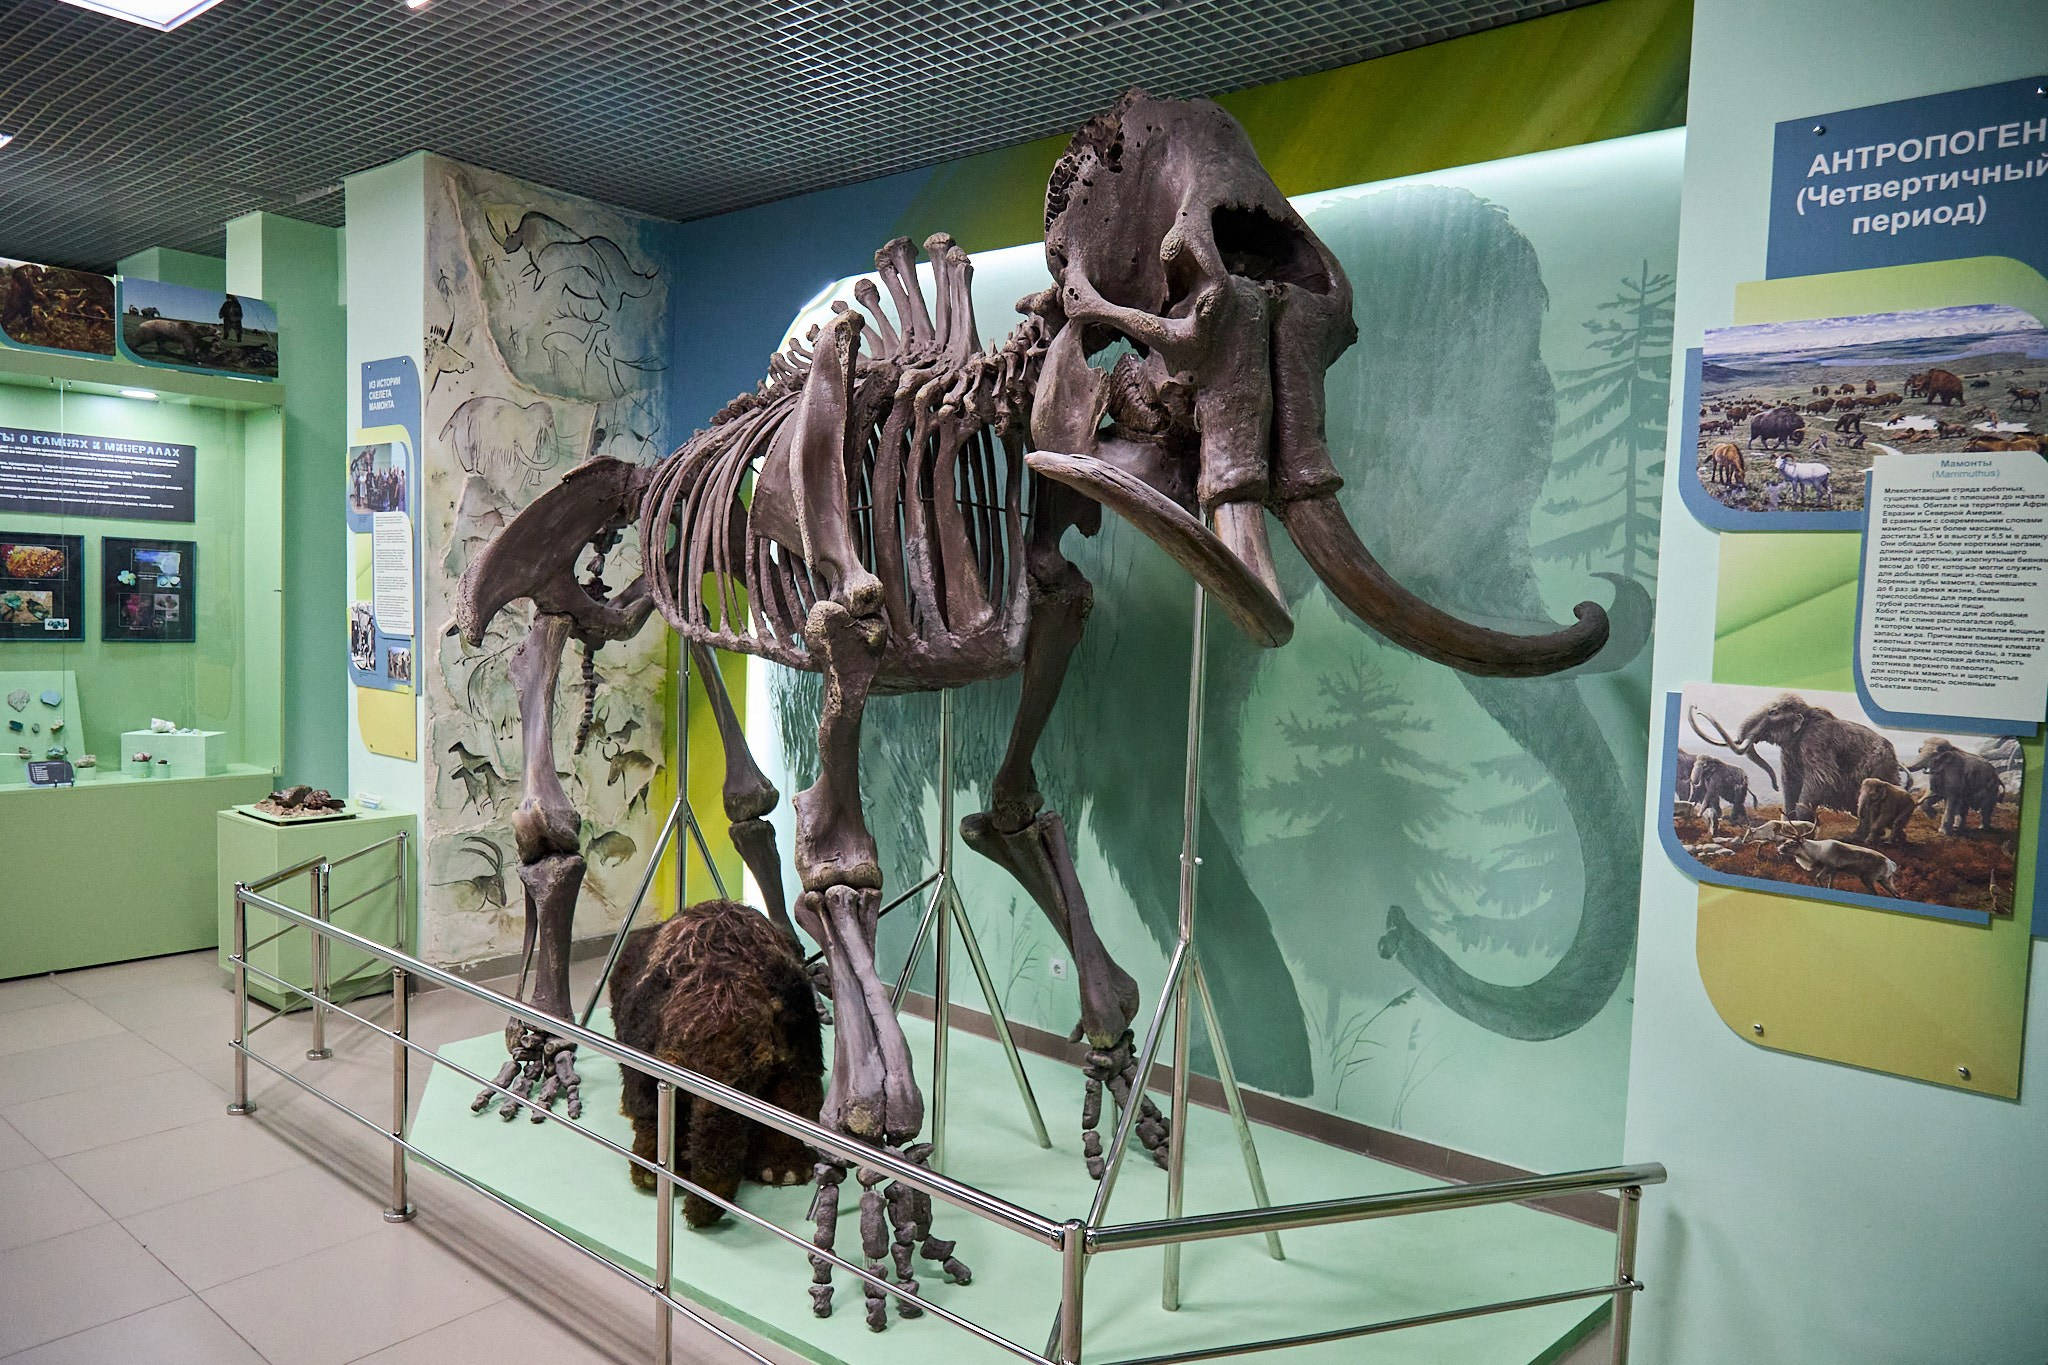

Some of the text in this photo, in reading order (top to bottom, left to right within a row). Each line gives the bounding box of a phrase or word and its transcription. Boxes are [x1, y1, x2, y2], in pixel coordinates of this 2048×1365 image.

[1807, 118, 2047, 178] АНТРОПОГЕН
[1796, 152, 2048, 215] (Четвертичный
[1852, 195, 1987, 235] период)
[368, 376, 401, 389] ИЗ ИСТОРИИ
[368, 389, 393, 400] СКЕЛЕТА
[368, 400, 395, 411] МАМОНТА
[32, 435, 88, 449] КАМНЯХ
[105, 442, 180, 458] МИНЕРАЛАХ
[1940, 459, 1993, 468] Мамонты
[1932, 469, 2001, 480] (Mammuthus)
[1898, 540, 1935, 548] обладали
[1878, 578, 1916, 586] Коренные
[1876, 600, 1902, 608] грубой
[1980, 611, 2028, 619] добывания
[1928, 632, 1972, 641] Причинами
[1975, 635, 2023, 643] вымирания
[1934, 648, 1972, 656] кормовой
[1913, 663, 1948, 671] верхнего
[1887, 669, 1919, 677] которых
[1870, 682, 1911, 690] объектами
